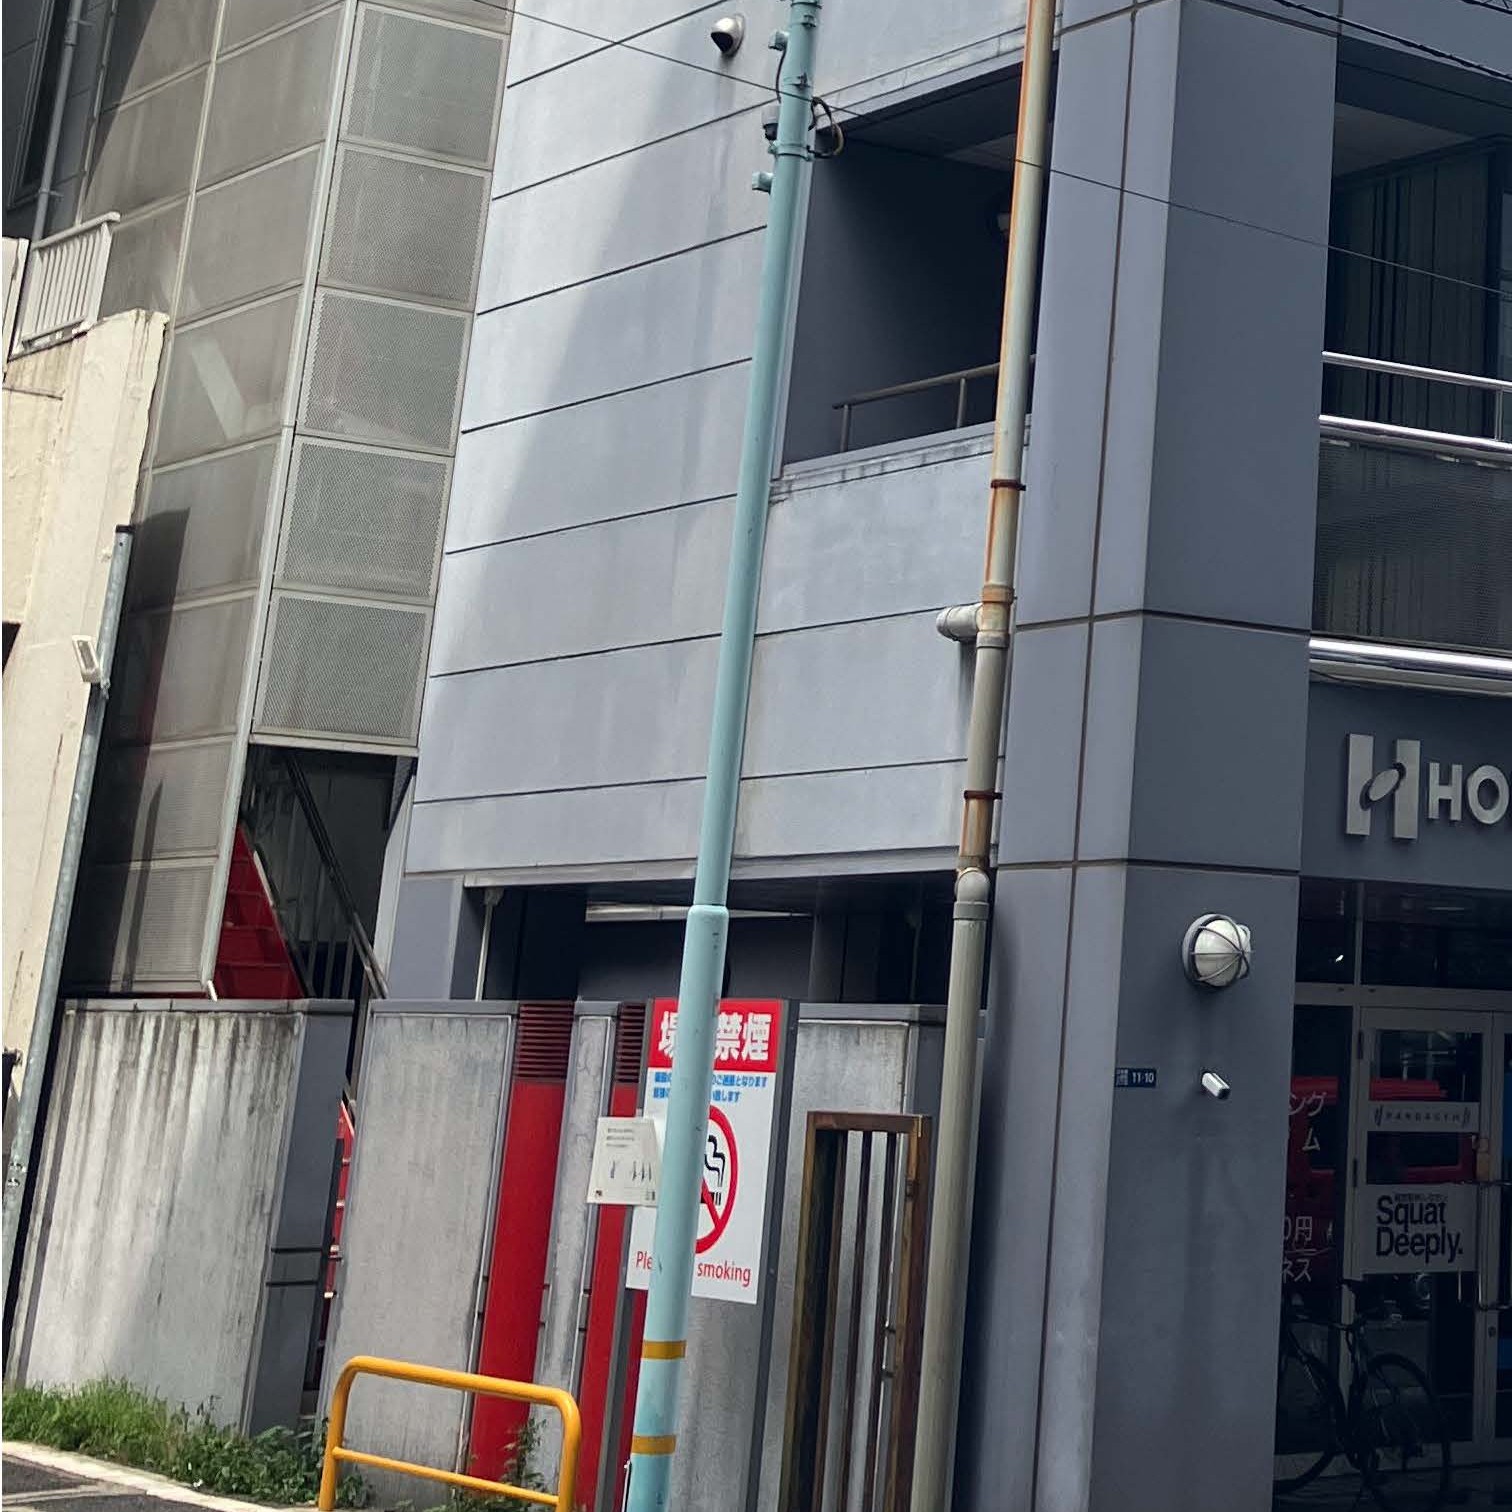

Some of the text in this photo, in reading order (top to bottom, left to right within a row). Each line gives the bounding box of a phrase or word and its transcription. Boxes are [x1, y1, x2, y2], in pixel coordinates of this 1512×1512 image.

[1376, 1195, 1448, 1233] Squat
[1376, 1226, 1464, 1265] Deeply.
[697, 1259, 752, 1287] smoking
